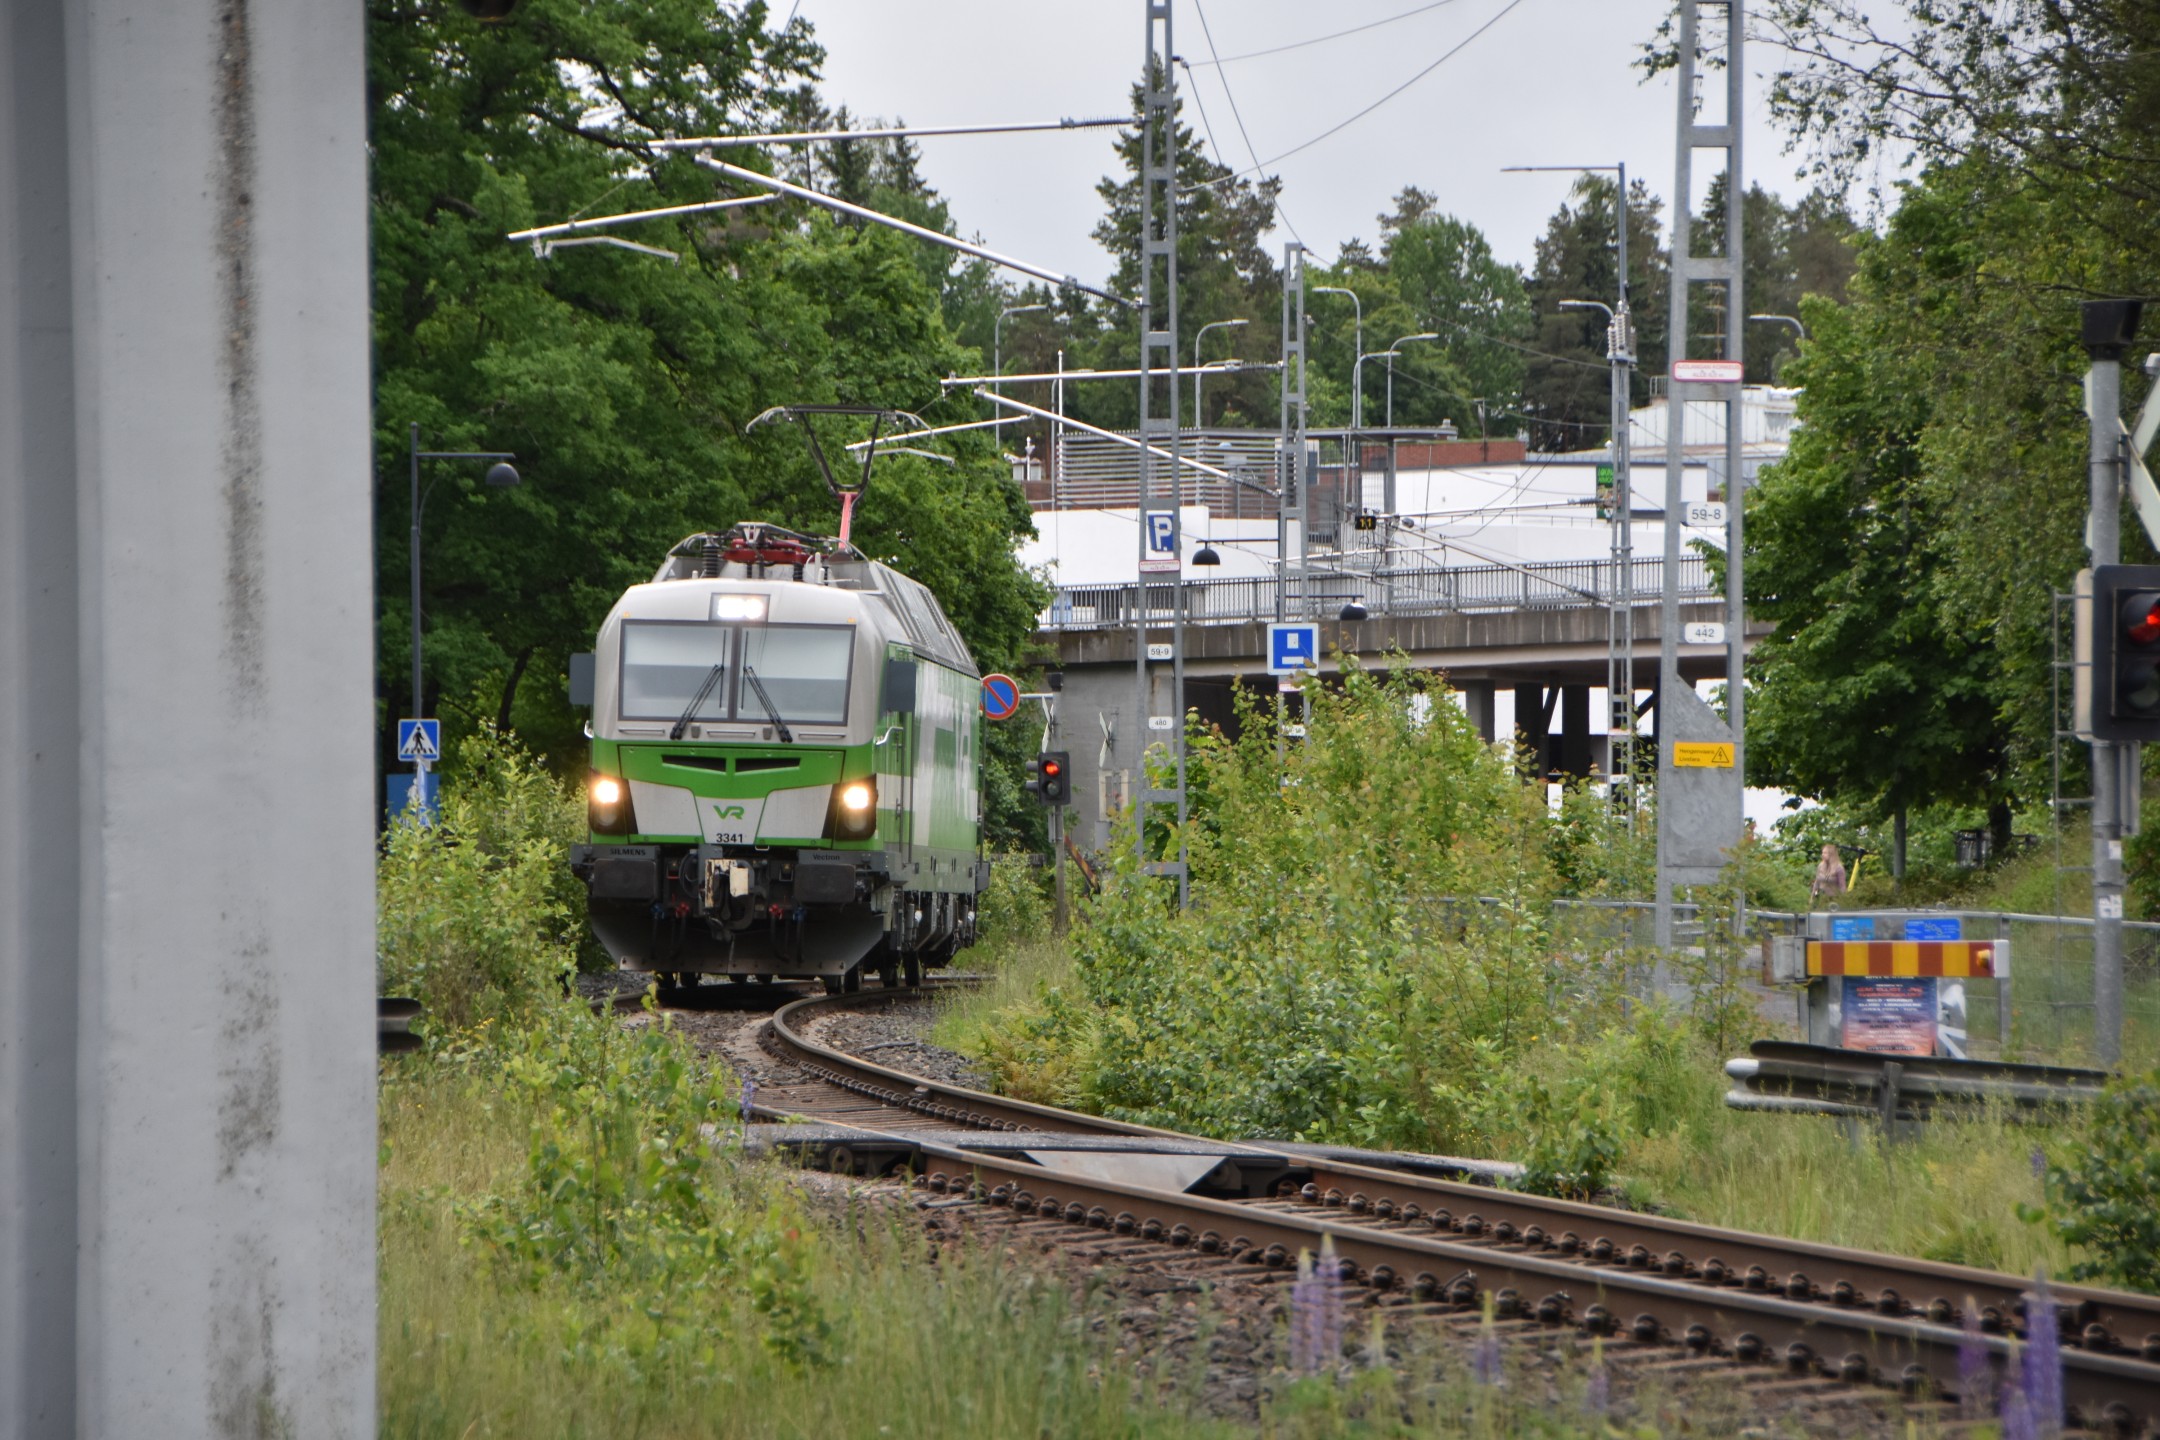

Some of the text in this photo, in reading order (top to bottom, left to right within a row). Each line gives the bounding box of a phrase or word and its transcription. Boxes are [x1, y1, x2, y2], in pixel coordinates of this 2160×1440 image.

[1691, 508, 1721, 520] 59-8
[1153, 516, 1173, 550] P
[1695, 628, 1715, 638] 442
[1150, 647, 1170, 656] 59-9
[1154, 719, 1167, 727] 480
[713, 804, 745, 820] VR
[716, 833, 743, 843] 3341
[609, 848, 646, 856] SIEMENS
[812, 852, 840, 861] Vectron
